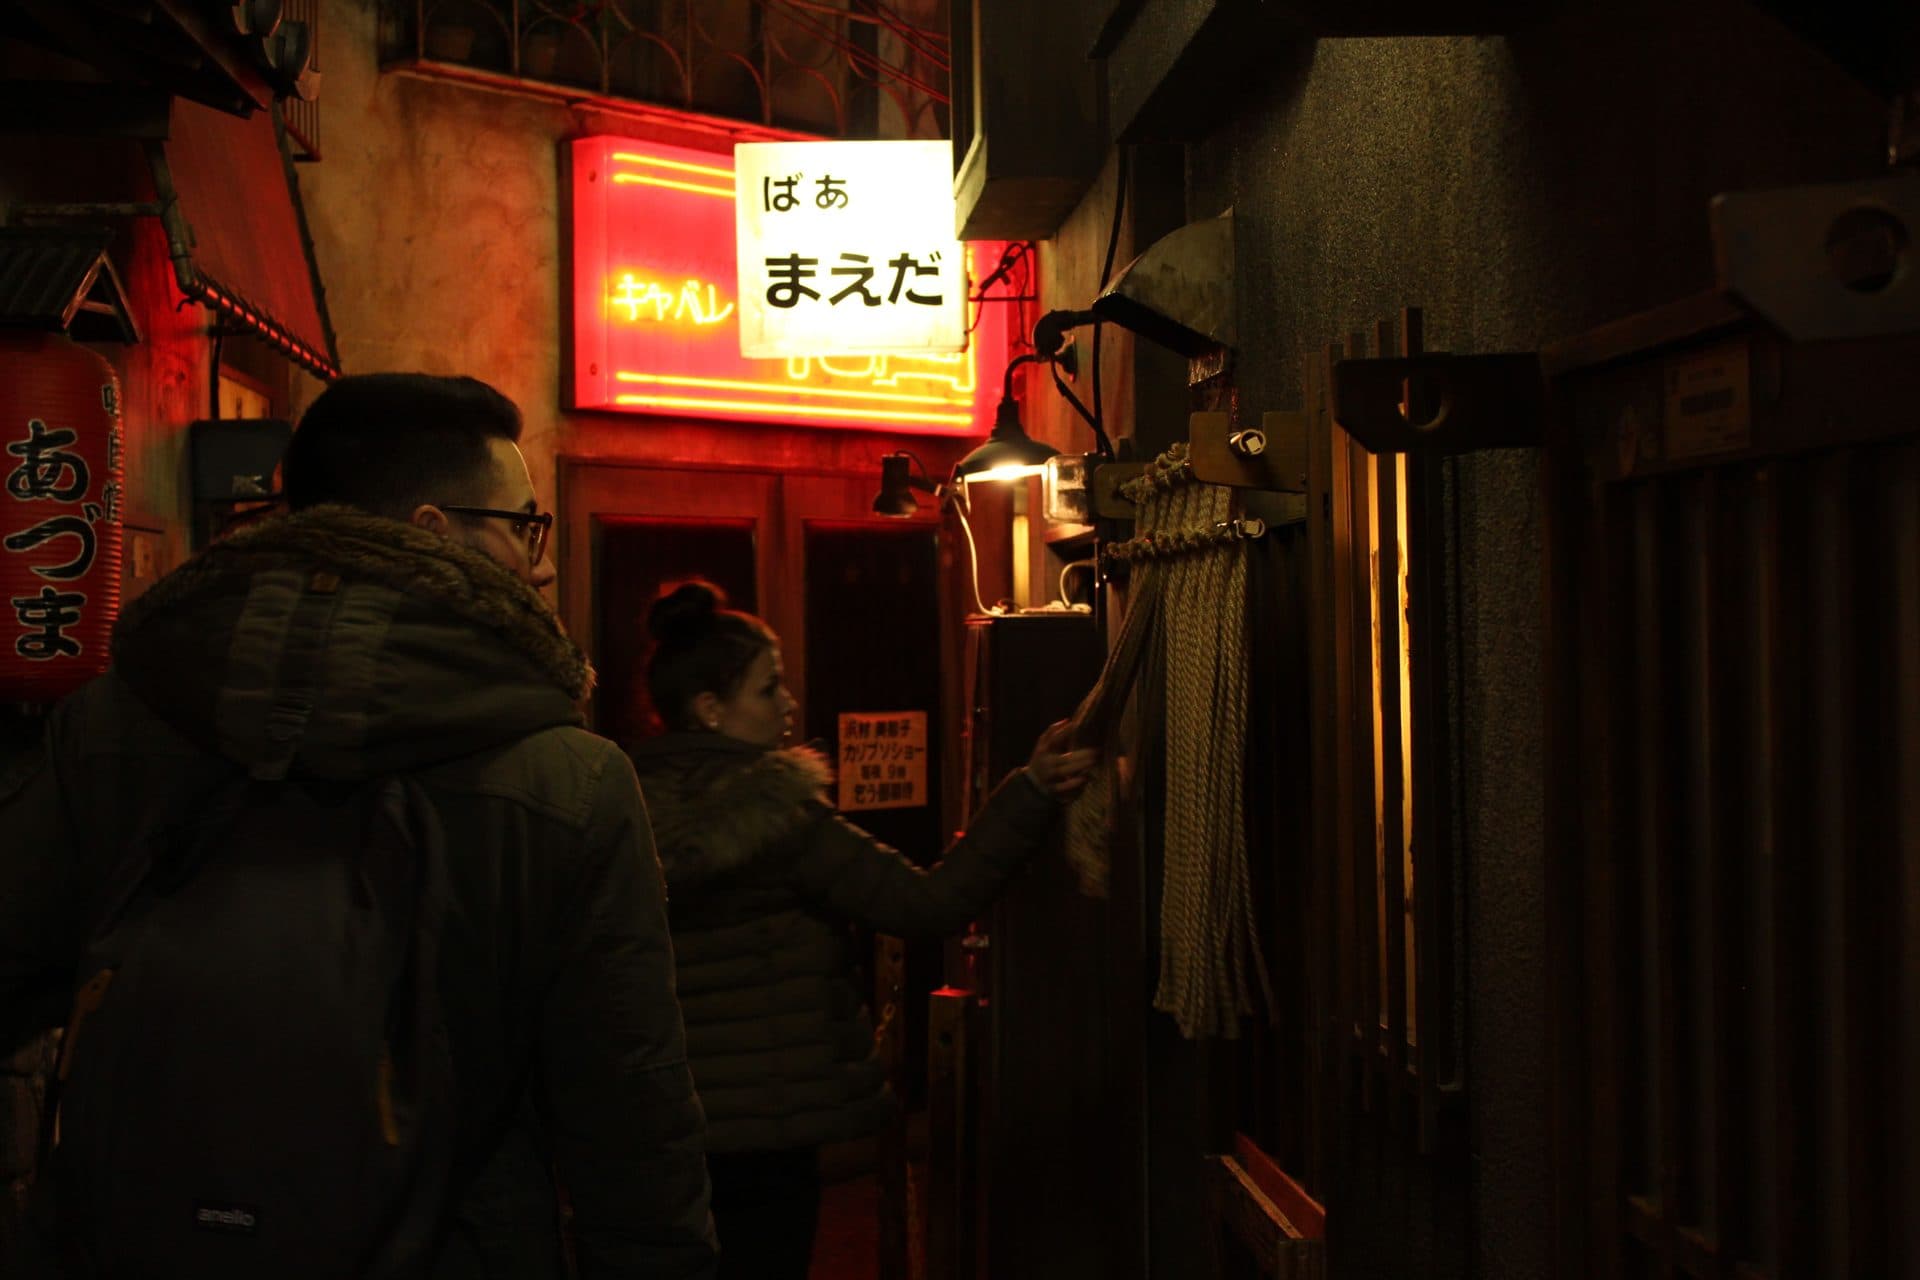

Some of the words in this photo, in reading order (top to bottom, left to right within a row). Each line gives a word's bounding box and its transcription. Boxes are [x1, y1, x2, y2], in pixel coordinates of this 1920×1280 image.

[765, 251, 943, 308] まえだ
[4, 418, 101, 661] あづま
